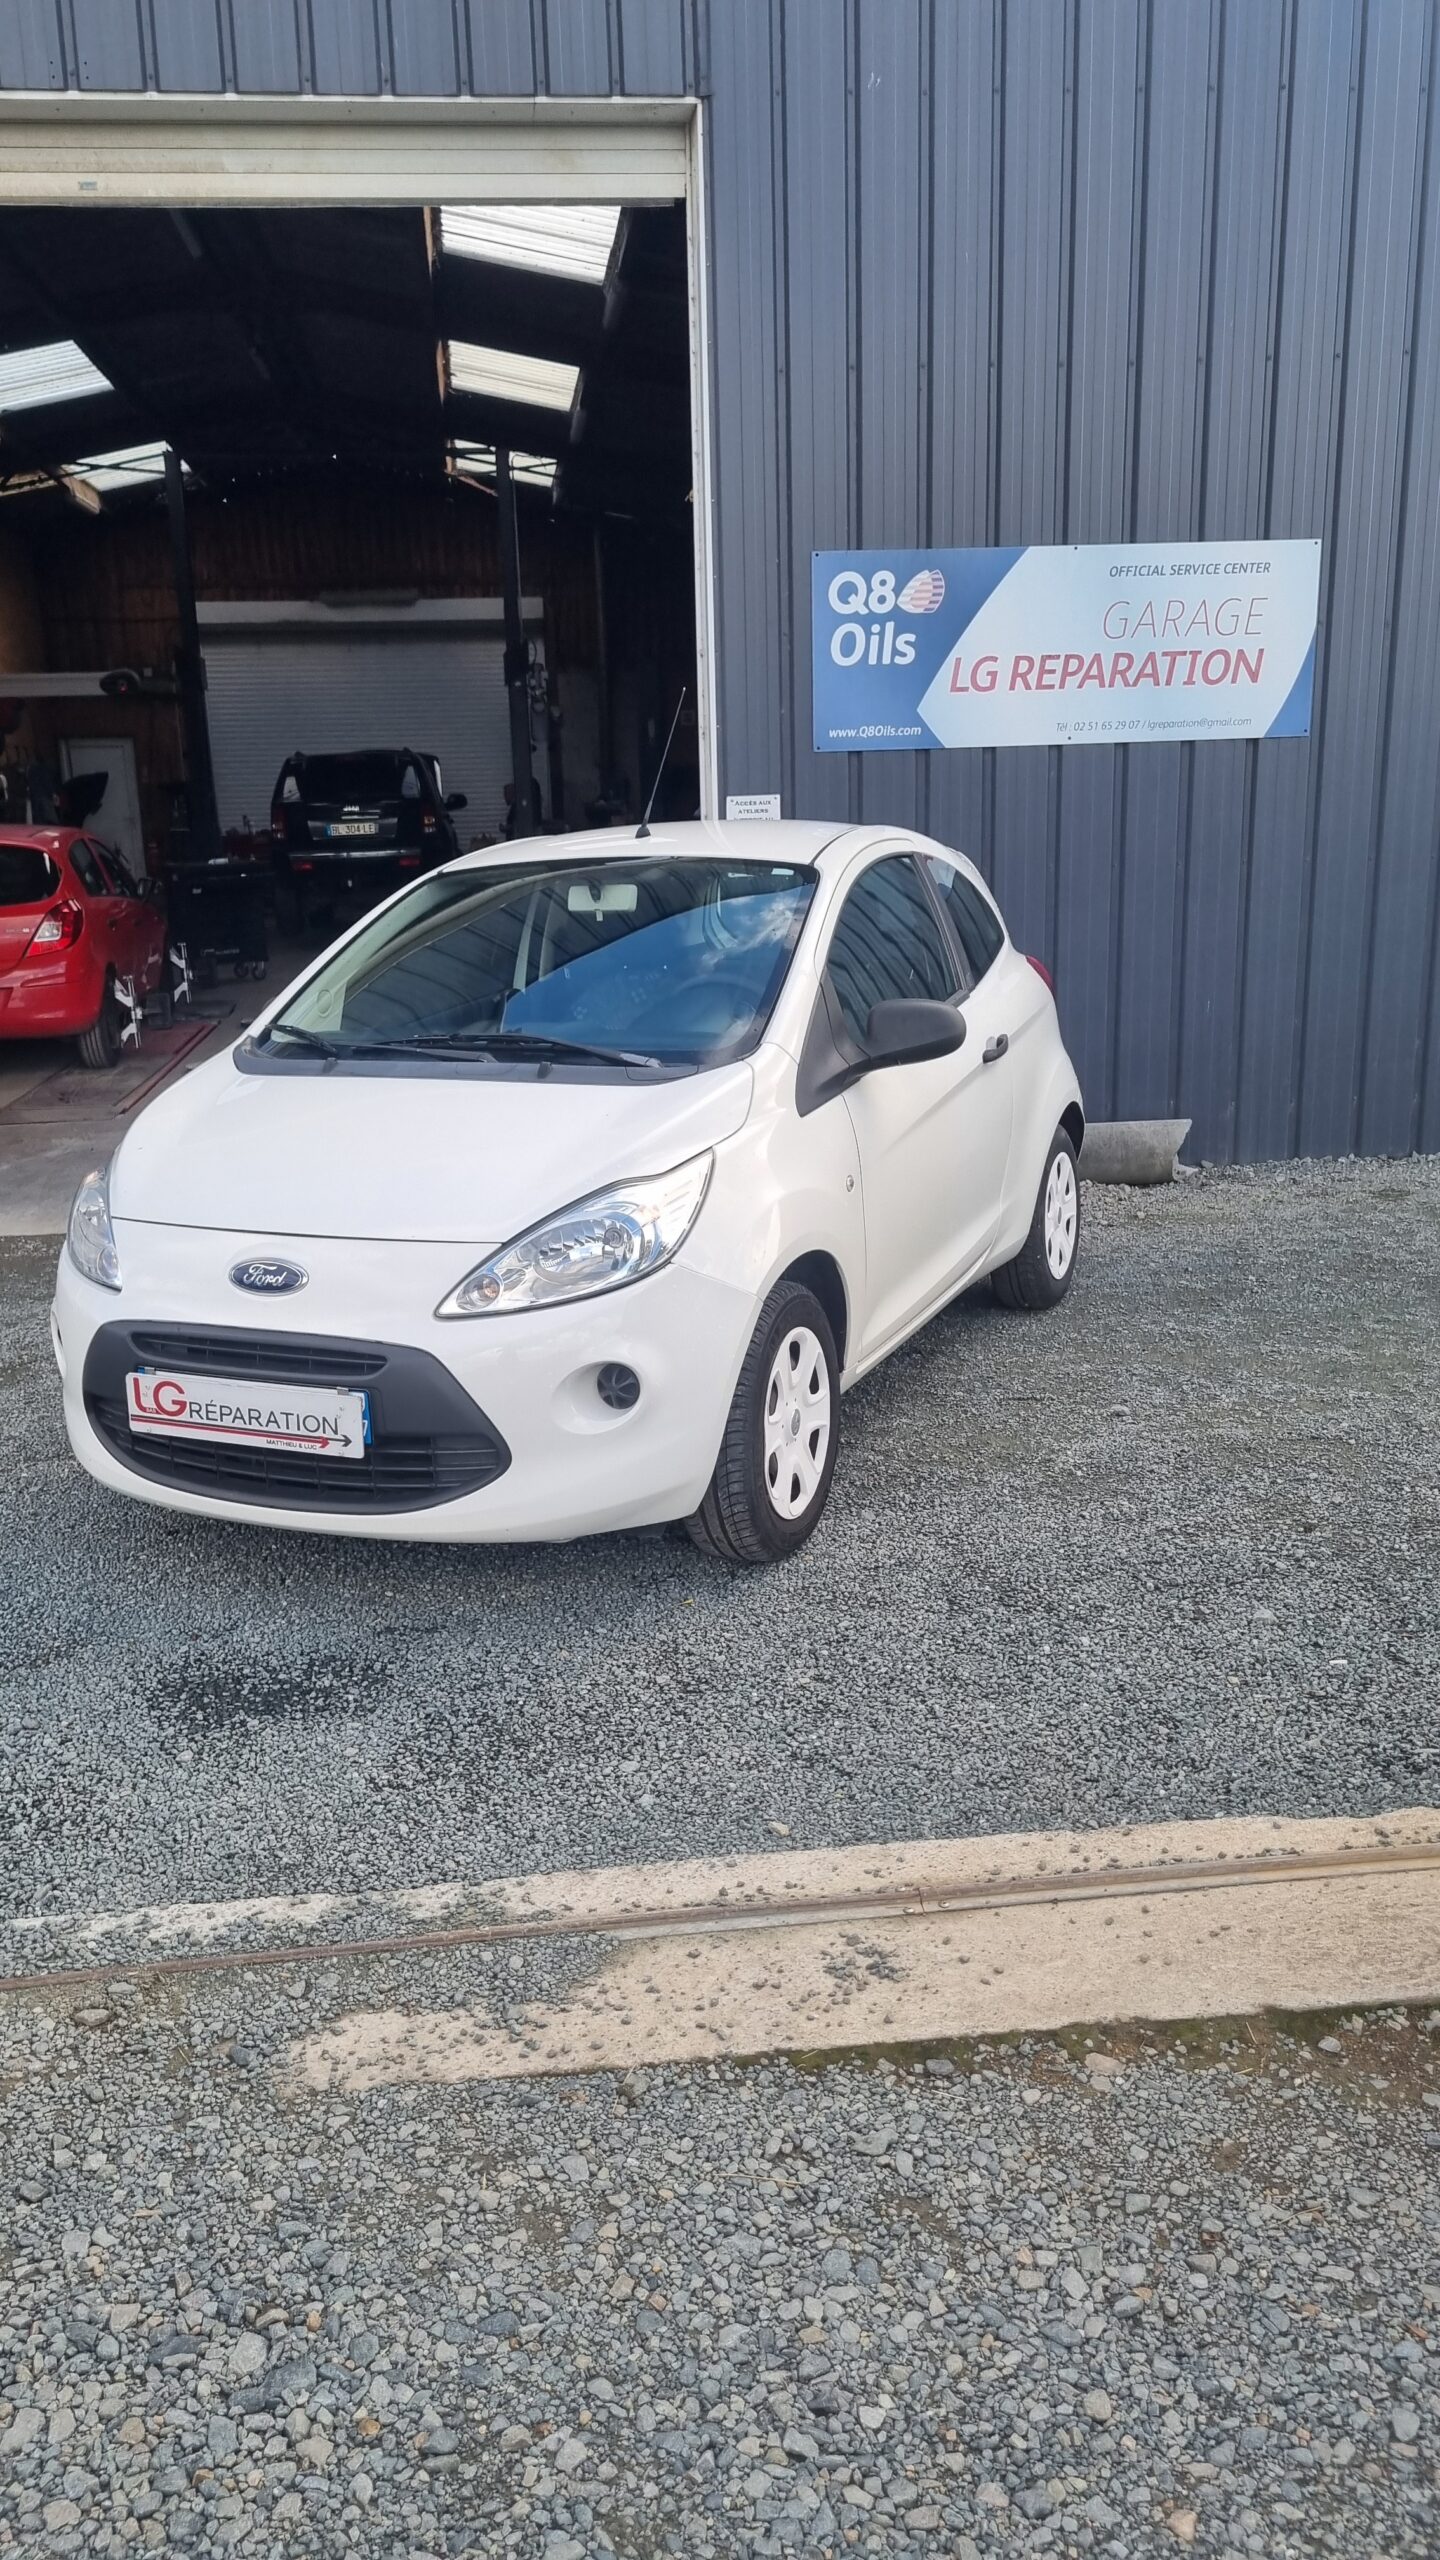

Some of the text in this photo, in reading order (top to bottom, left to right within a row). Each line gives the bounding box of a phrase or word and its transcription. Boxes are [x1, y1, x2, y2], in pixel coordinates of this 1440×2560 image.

[1108, 561, 1271, 578] OFFICIAL SERVICE CENTER
[828, 570, 896, 615] Q8
[1102, 597, 1269, 640] GARAGE
[830, 621, 917, 666] Oils
[949, 647, 1265, 693] LG REPARATION
[828, 724, 922, 738] www.Q8Oils.com
[1073, 721, 1086, 732] 02
[1088, 721, 1099, 731] 51
[1101, 720, 1113, 731] 65
[1114, 720, 1127, 730] 29
[1128, 719, 1141, 730] 07
[1147, 716, 1252, 732] lgreparation@gmail.com
[243, 1263, 288, 1287] Ford
[132, 1377, 339, 1436] LG RÉPARATION
[266, 1439, 297, 1448] MATTHIEU
